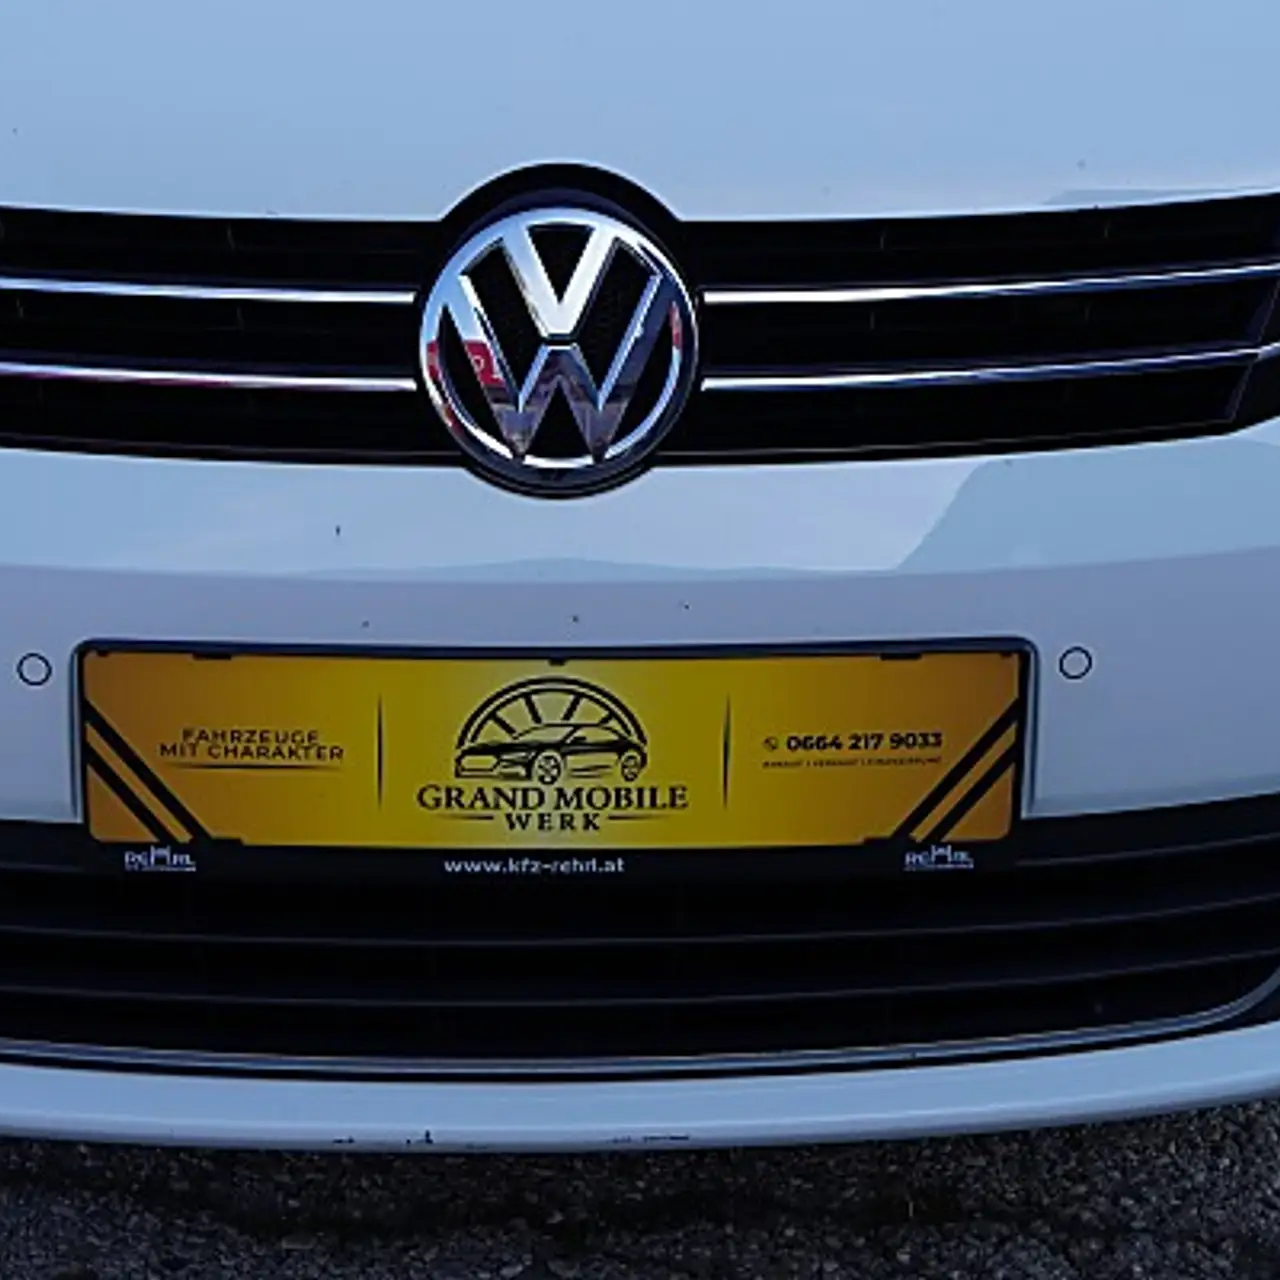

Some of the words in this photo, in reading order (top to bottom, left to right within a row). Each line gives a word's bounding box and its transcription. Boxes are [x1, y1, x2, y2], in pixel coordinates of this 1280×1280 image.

[182, 728, 319, 745] FAHRZEUGE
[786, 734, 844, 752] 0664
[848, 732, 884, 751] 217
[889, 731, 943, 750] 9033
[160, 743, 197, 759] MIT
[208, 744, 344, 762] CHARAKTER
[416, 784, 545, 811] GRAND
[553, 784, 689, 810] MOBILE
[505, 812, 601, 831] WERK
